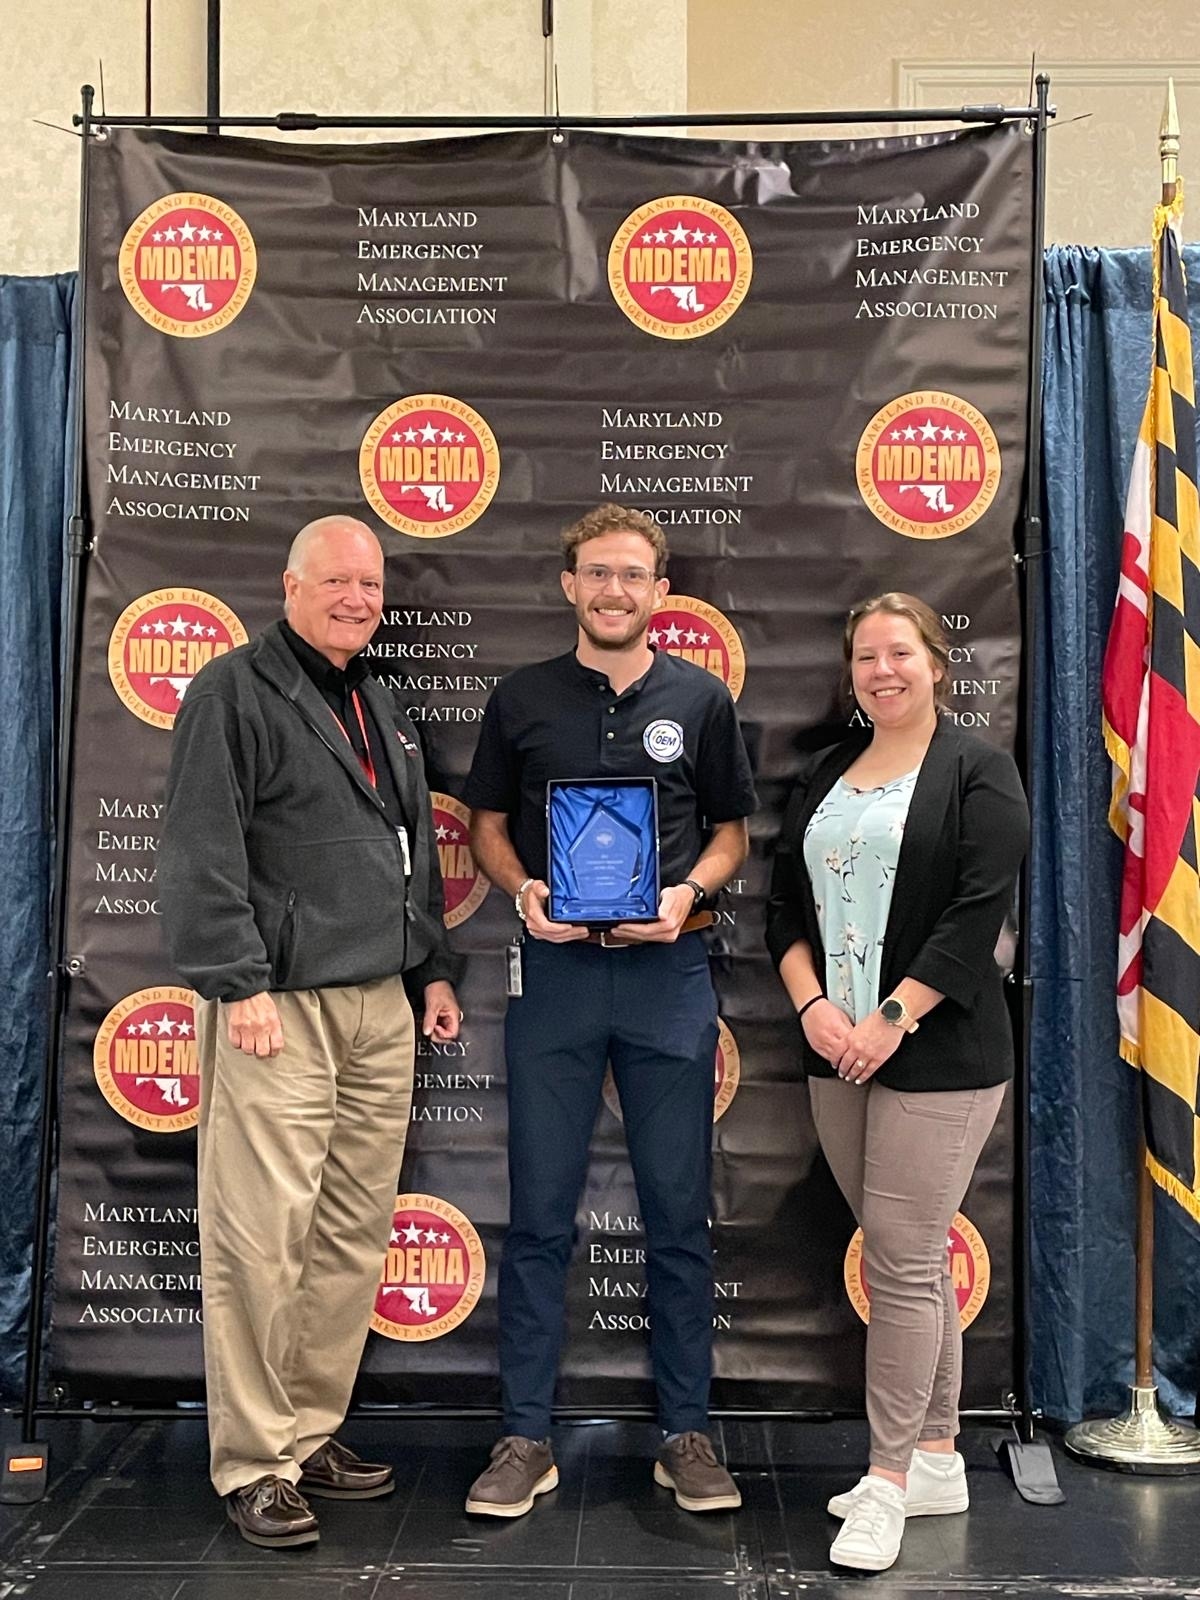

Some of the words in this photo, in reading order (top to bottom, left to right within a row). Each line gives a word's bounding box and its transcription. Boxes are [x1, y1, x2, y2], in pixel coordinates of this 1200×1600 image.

[125, 198, 182, 252] MARYLAND
[189, 196, 252, 254] EMERGENCY
[614, 200, 675, 255] MARYLAND
[682, 199, 748, 255] EMERGENCY
[139, 245, 237, 281] MDEMA
[629, 247, 732, 283] MDEMA
[123, 266, 187, 333] MANAGEMENT
[193, 268, 252, 333] ASSOCIATION
[612, 270, 678, 335] MANAGEMENT
[683, 271, 748, 335] ASSOCIATION
[364, 399, 424, 455] MARYLAND
[430, 397, 496, 455] EMERGENCY
[862, 395, 924, 452] MARYLAND
[931, 394, 997, 455] EMERGENCY
[379, 446, 480, 482] MDEMA
[877, 444, 981, 482] MDEMA
[363, 468, 429, 534] MANAGEMENT
[433, 470, 496, 534] ASSOCIATION
[860, 466, 926, 535] MANAGEMENT
[932, 469, 997, 534] ASSOCIATION
[114, 592, 175, 646] MARYLAND
[182, 591, 244, 642] EMERGENC
[675, 599, 740, 657] EMERGENCY
[359, 643, 479, 659] MERGENCY
[376, 674, 502, 691] ANAGEMENT
[655, 735, 677, 747] OEM
[98, 797, 164, 819] MARY
[100, 991, 162, 1046] MARYLAND
[114, 1038, 201, 1076] MDEM
[97, 1060, 163, 1128] MANAGEMENT
[82, 1235, 200, 1257] EMERGENC
[415, 1198, 481, 1256] EMERGENCY
[380, 1247, 465, 1284] DEMA
[416, 1272, 481, 1337] ASSOCIATION
